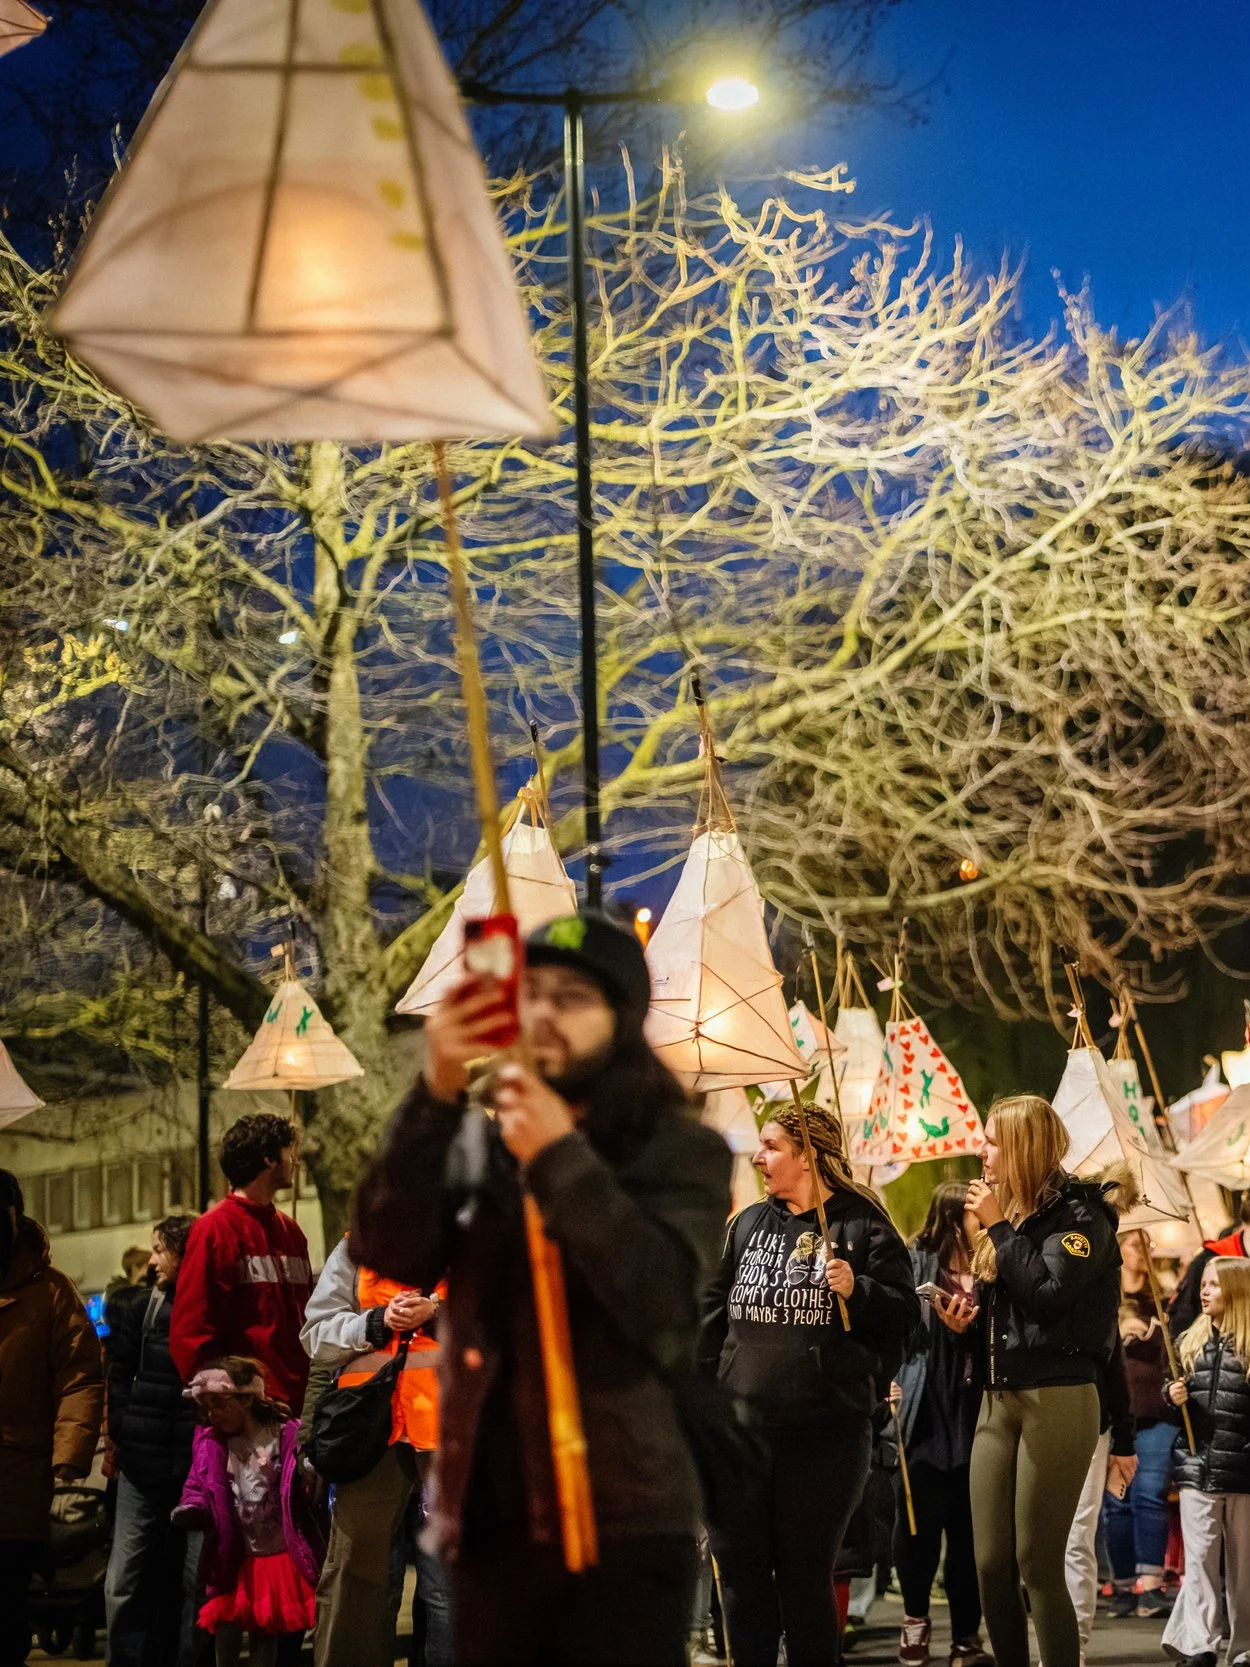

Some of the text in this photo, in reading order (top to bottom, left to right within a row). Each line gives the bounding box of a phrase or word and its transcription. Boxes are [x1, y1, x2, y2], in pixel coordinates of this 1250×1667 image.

[748, 1230, 786, 1252] I LIKE
[740, 1248, 783, 1268] MURDER
[730, 1285, 833, 1309] COMFY CLOTHES
[745, 1305, 778, 1323] MAYBE
[782, 1308, 789, 1324] 3
[793, 1309, 832, 1326] PEOPLE
